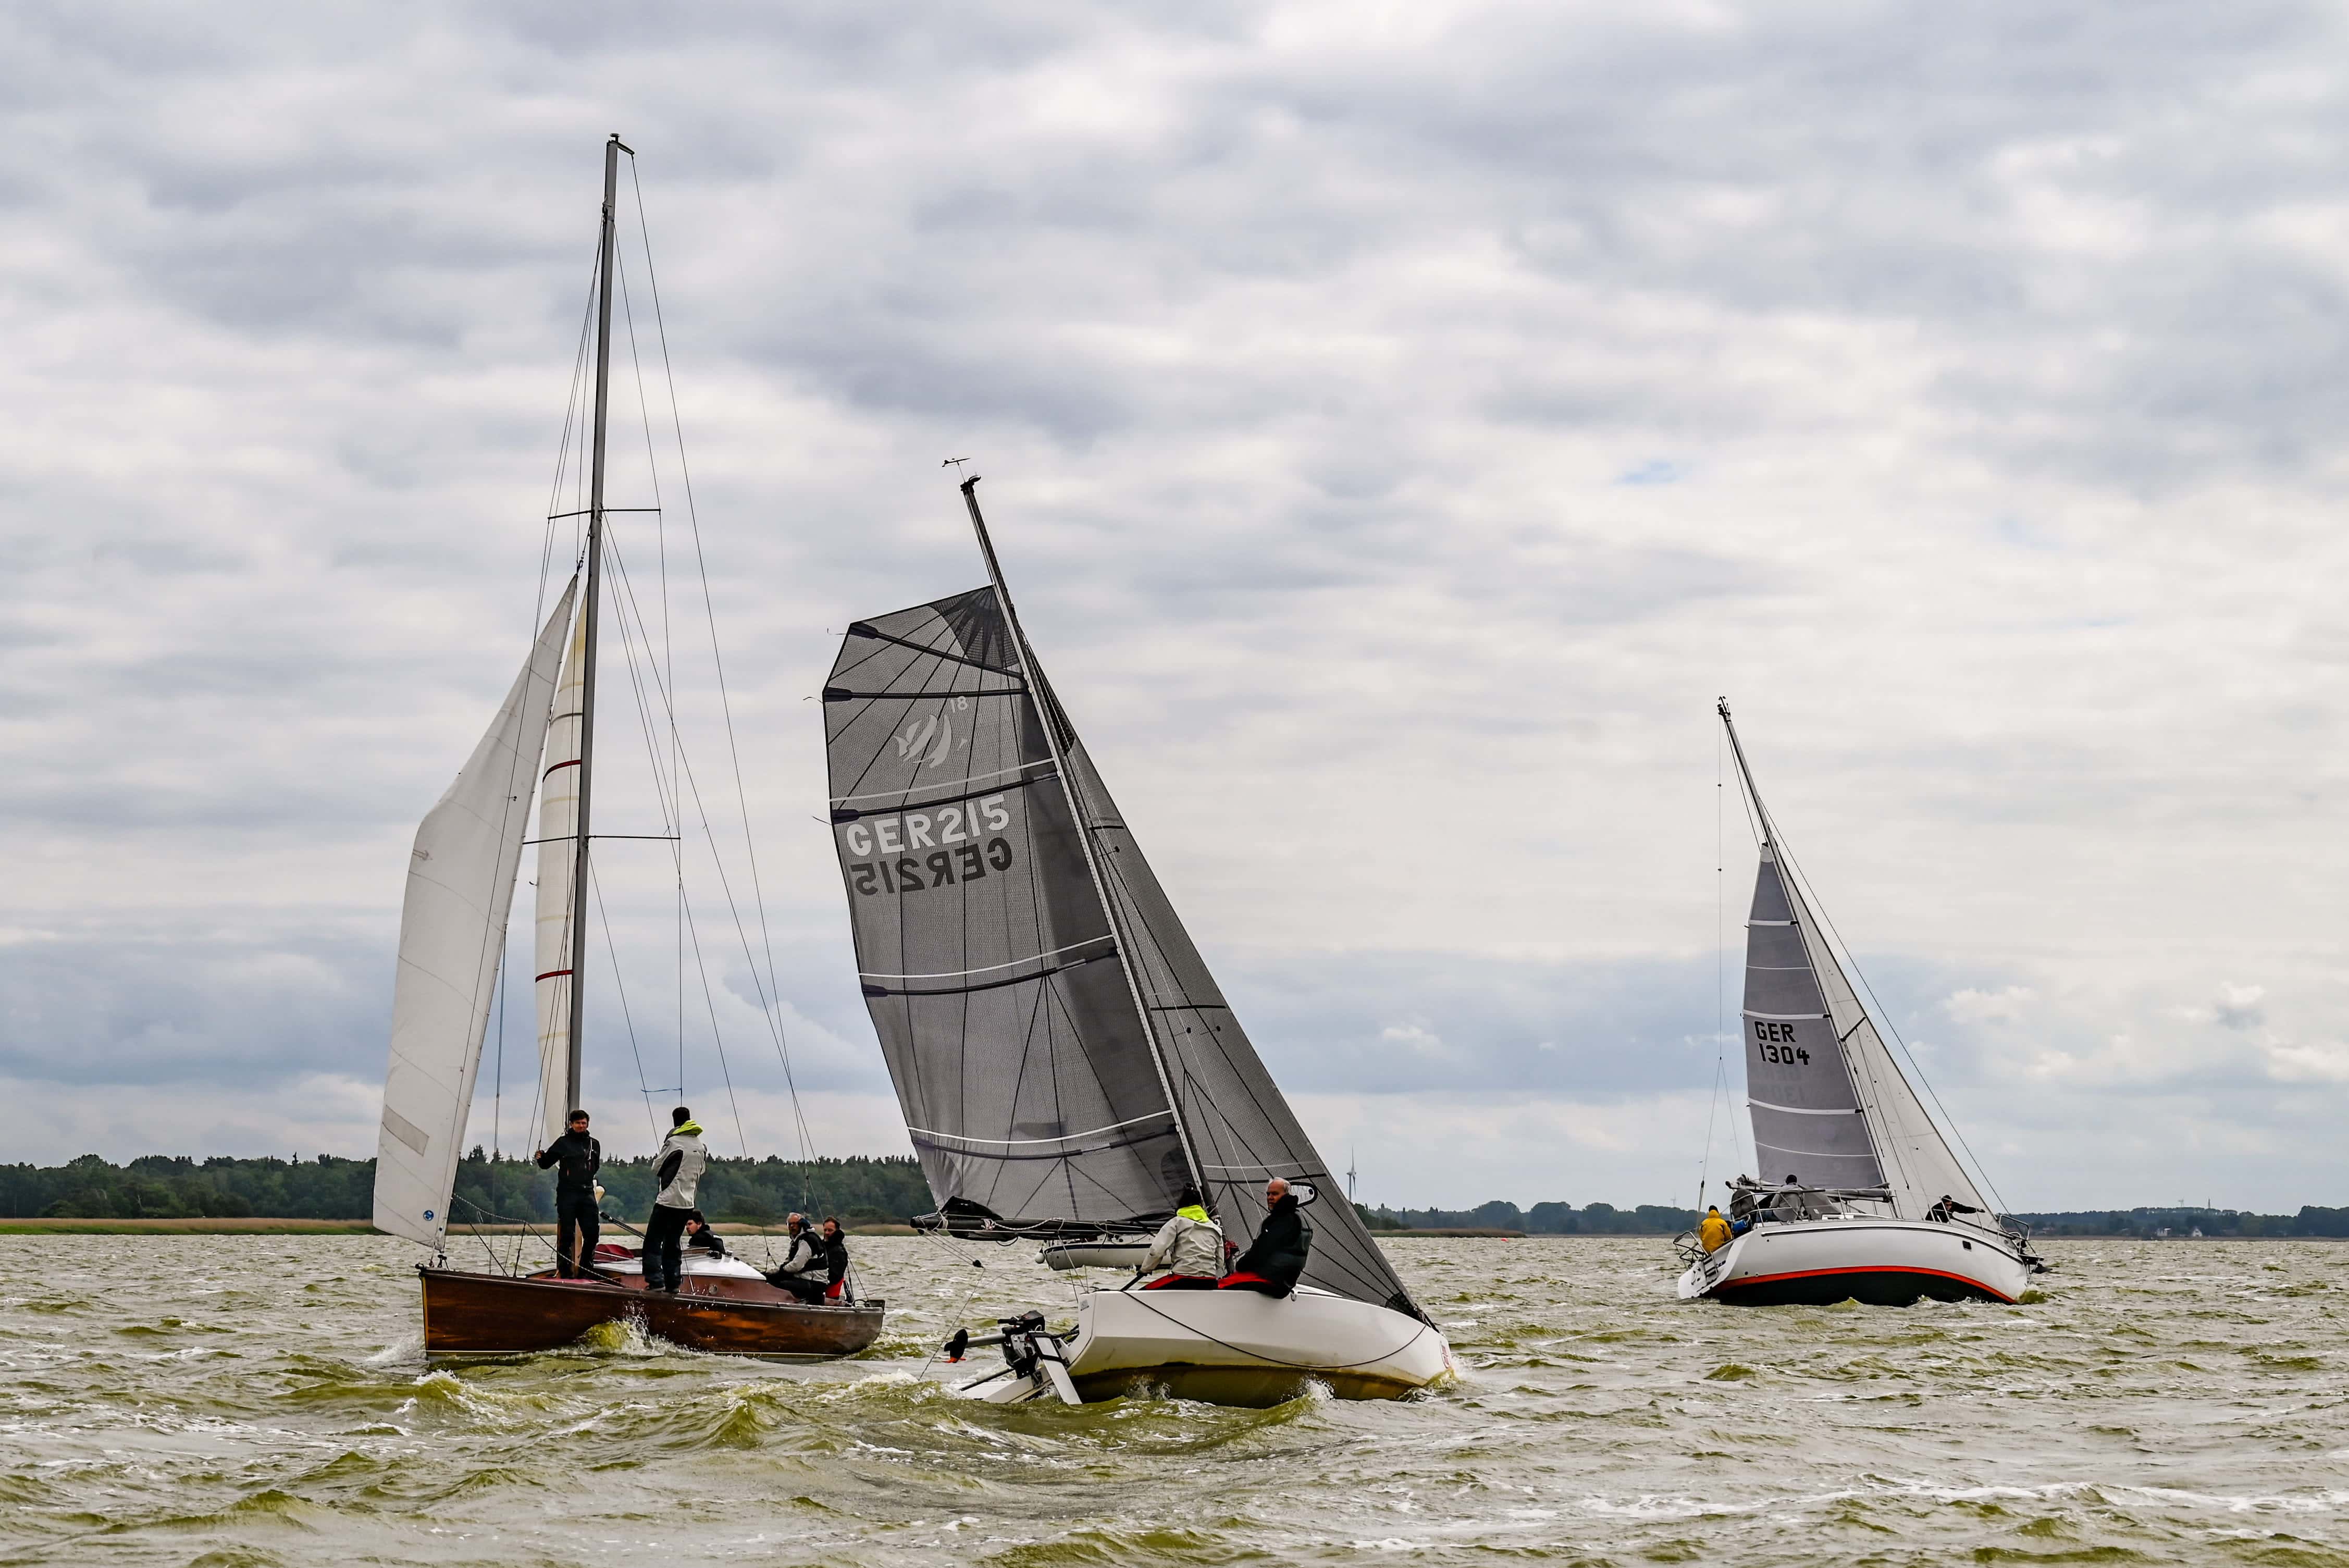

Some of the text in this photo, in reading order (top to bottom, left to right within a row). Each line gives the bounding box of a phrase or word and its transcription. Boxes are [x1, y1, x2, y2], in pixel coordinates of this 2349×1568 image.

[847, 794, 1009, 856] GER215
[1754, 1021, 1796, 1042] GER
[1759, 1043, 1810, 1065] 1304
